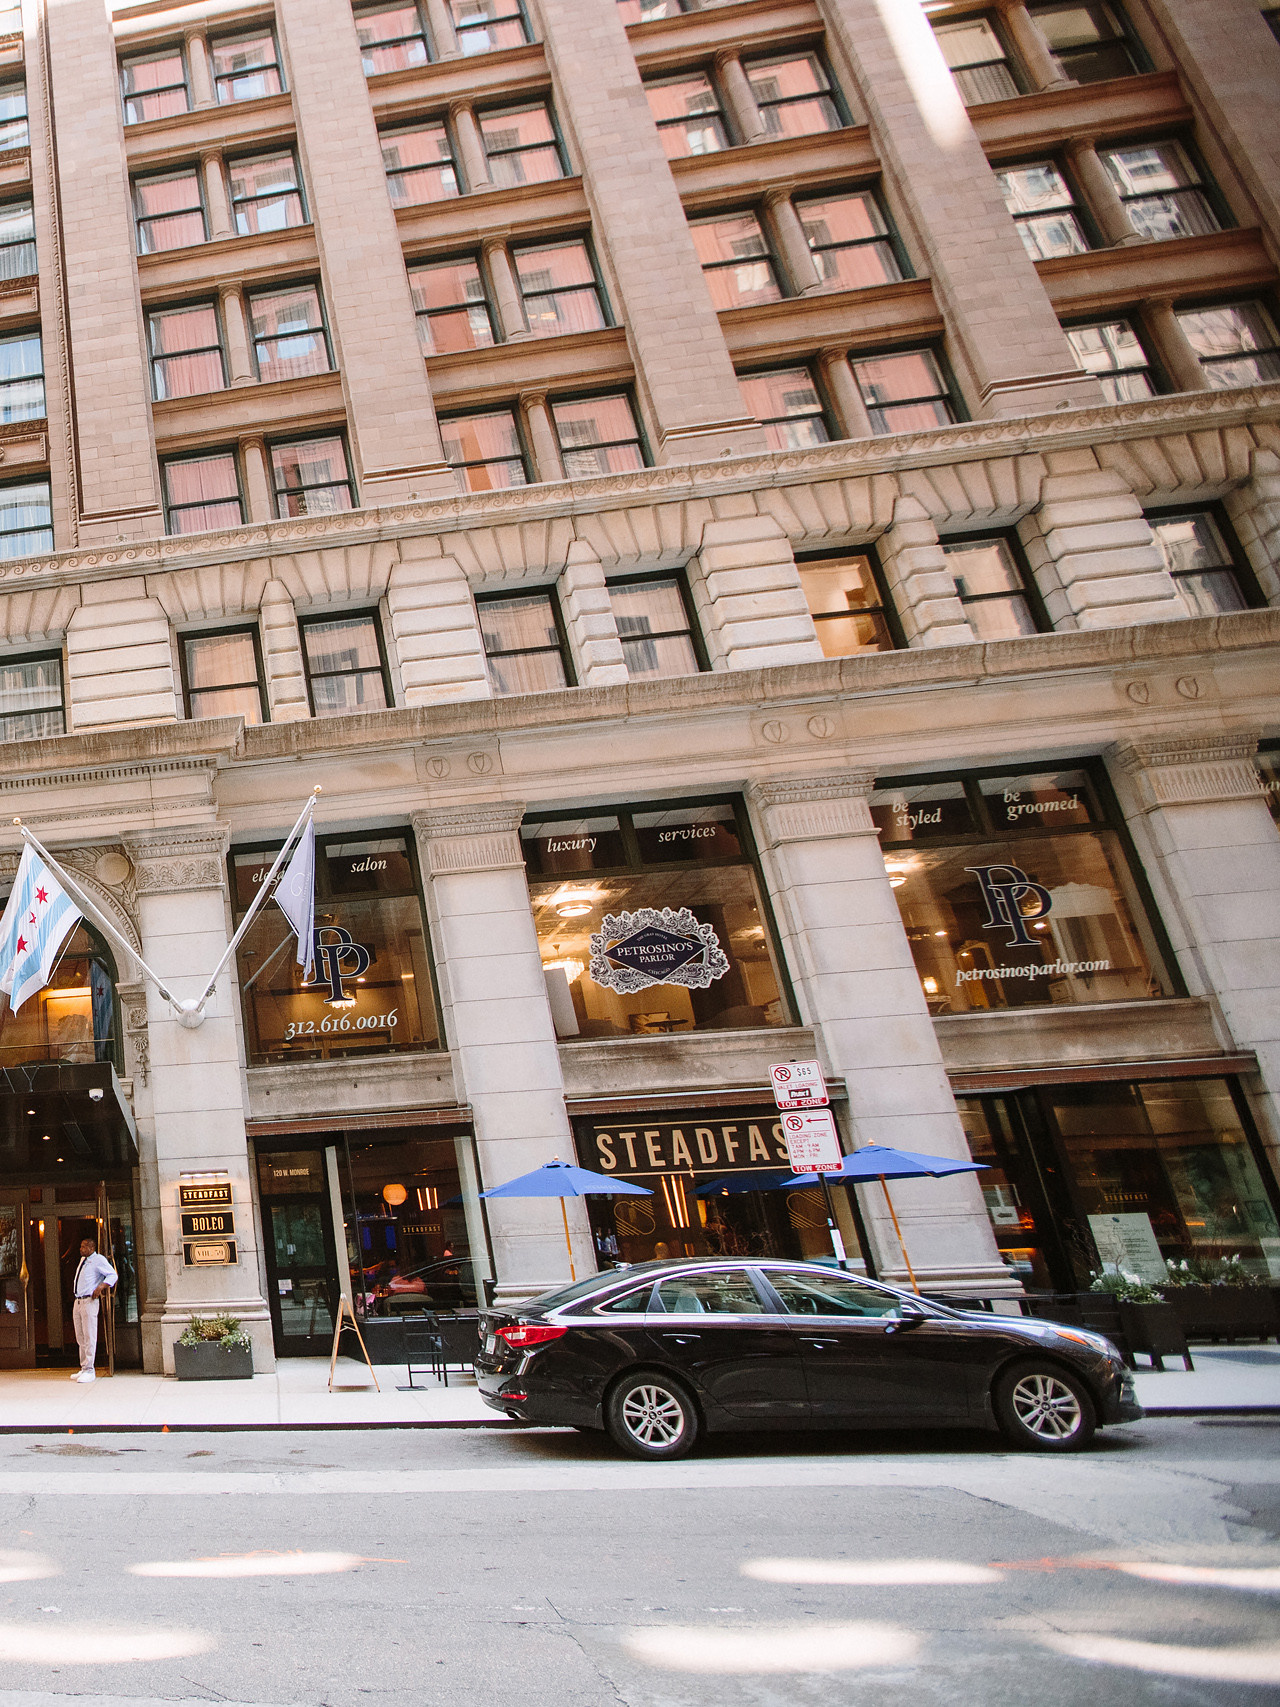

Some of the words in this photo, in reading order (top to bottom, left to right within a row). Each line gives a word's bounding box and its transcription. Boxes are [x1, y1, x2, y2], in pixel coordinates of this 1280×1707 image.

[1003, 789, 1020, 803] be
[892, 801, 909, 813] be
[1007, 794, 1078, 821] groomed
[896, 807, 942, 830] styled
[547, 836, 597, 853] luxury
[658, 824, 716, 843] services
[350, 856, 387, 873] salon
[616, 941, 693, 956] PETROSINO'S
[639, 953, 675, 963] PARLOR
[954, 958, 1110, 987] petrosinosparlor.com
[285, 1008, 399, 1041] 312.616.0016
[800, 1098, 823, 1106] ZONE
[596, 1123, 790, 1170] STEADFAS
[273, 1169, 283, 1177] 120
[289, 1168, 310, 1176] MONROE
[815, 1163, 838, 1171] ZONE
[183, 1190, 229, 1199] STEADFAST
[191, 1216, 225, 1232] BOLEO
[403, 1225, 440, 1233] STEADFAST
